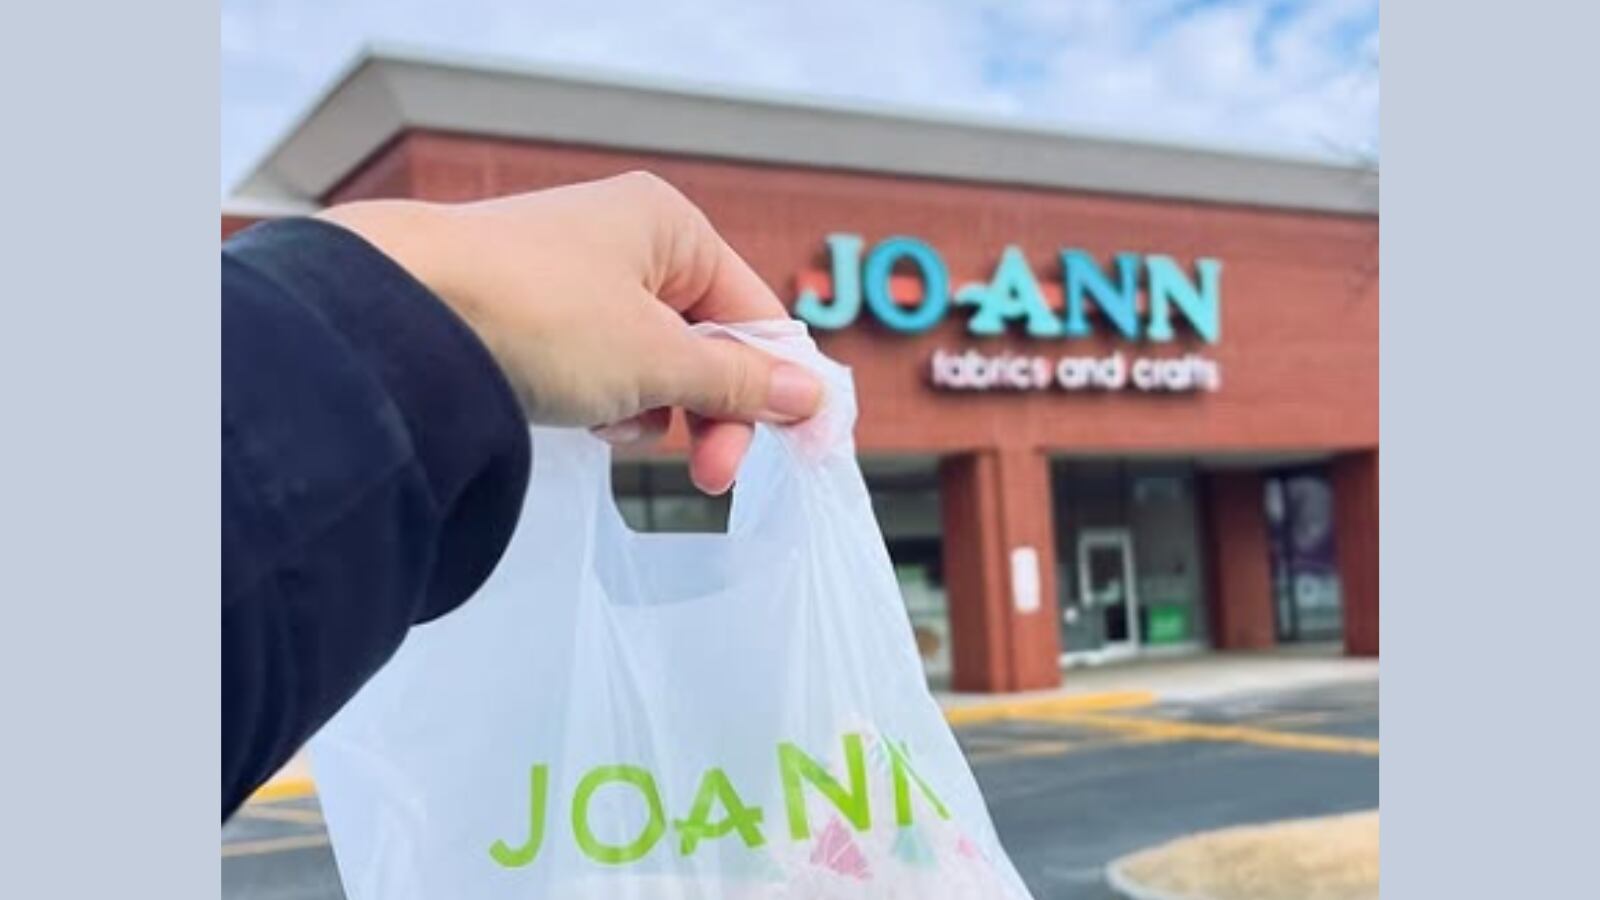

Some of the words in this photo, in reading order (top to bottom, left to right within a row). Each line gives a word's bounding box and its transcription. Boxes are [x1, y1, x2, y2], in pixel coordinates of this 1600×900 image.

[932, 350, 1049, 388] fabrics
[1056, 352, 1127, 389] and
[1132, 354, 1221, 392] crafts
